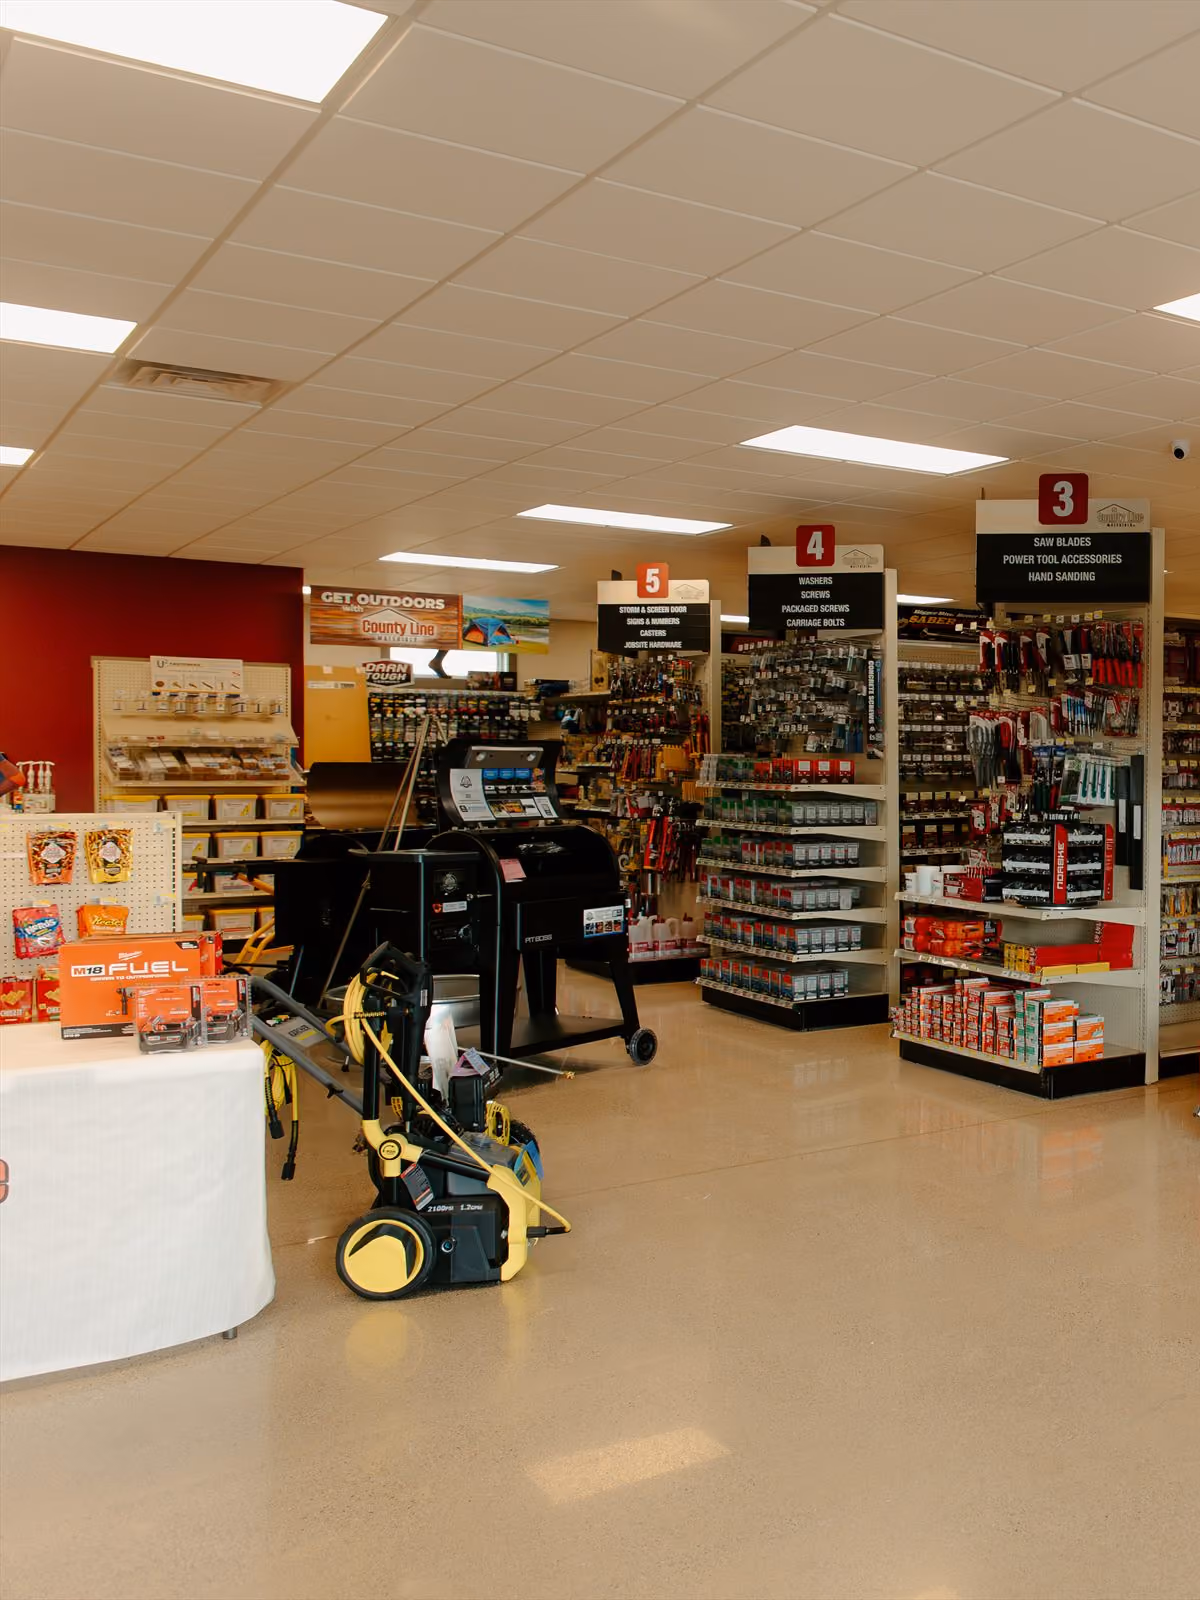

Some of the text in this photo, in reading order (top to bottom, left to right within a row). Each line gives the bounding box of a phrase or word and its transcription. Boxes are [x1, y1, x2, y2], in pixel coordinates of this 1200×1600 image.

[1052, 480, 1074, 517] 3
[806, 531, 825, 560] 4
[1034, 536, 1092, 547] SAW BLADES
[1003, 554, 1123, 564] POWER TOOL ACCESSORIES
[645, 568, 660, 593] 5
[798, 576, 833, 585] WASHERS
[1028, 571, 1096, 582] HAND SANDING
[801, 590, 831, 599] SCREWS
[321, 591, 446, 610] GET OUTDOORS
[342, 604, 364, 613] with
[619, 606, 640, 614] STORM
[781, 604, 850, 613] PACKAGED SCREWS
[786, 618, 845, 627] CARRIAGE BOLTS
[362, 619, 435, 637] County Line
[640, 629, 667, 637] CASTERS
[365, 663, 408, 673] DARN
[366, 672, 407, 681] TOUGH
[535, 934, 553, 942] BOSS
[73, 960, 189, 975] M18 FUEL
